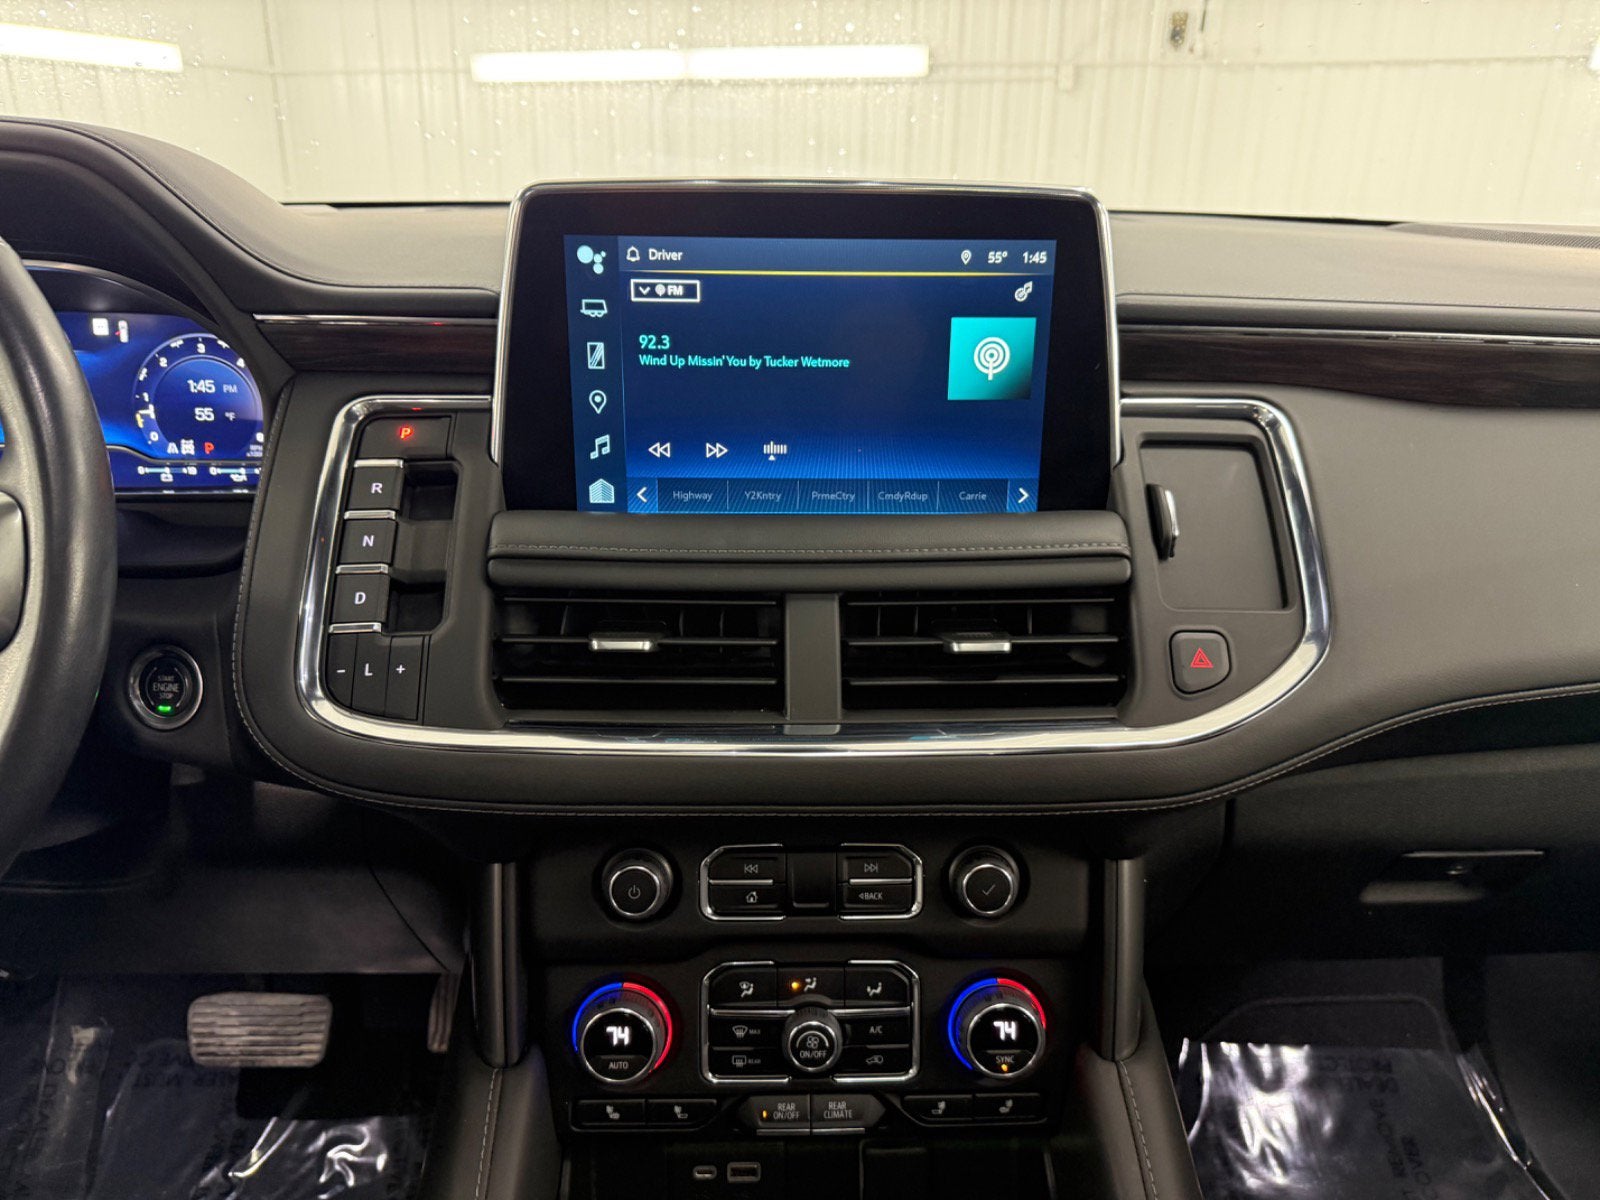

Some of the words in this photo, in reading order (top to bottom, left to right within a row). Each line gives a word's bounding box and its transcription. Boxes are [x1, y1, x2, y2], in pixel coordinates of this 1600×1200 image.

[648, 249, 683, 261] Driver
[1022, 251, 1048, 264] 1:45
[667, 285, 683, 296] FM
[639, 335, 671, 350] 92.3
[639, 355, 667, 367] Wind
[669, 355, 685, 369] Up
[727, 356, 746, 368] You
[749, 356, 761, 371] by
[763, 356, 798, 369] Tucker
[801, 356, 850, 369] Wetmore
[187, 379, 216, 393] 1:45
[194, 407, 215, 421] 55
[400, 427, 412, 439] P
[204, 442, 214, 455] P
[371, 481, 383, 495] R
[672, 490, 713, 503] Highway
[744, 490, 782, 503] Y2Kntry
[811, 490, 856, 503] PrmeCtry
[877, 490, 929, 503] CmdyRdup
[958, 490, 988, 501] Carrie
[362, 535, 375, 548] N
[354, 592, 366, 605] D
[364, 663, 373, 677] L
[153, 683, 179, 692] ENGINE
[864, 891, 883, 901] BACK
[606, 1026, 630, 1046] 74
[869, 1025, 883, 1035] A/C
[993, 1021, 1017, 1041] 74
[799, 1050, 828, 1060] ON/OFF
[995, 1055, 1015, 1065] SYNC
[608, 1061, 629, 1070] AUTO
[777, 1103, 796, 1112] REAR
[828, 1101, 847, 1111] REAR
[773, 1111, 801, 1121] ON/OFF
[823, 1110, 854, 1120] CLIMATE
